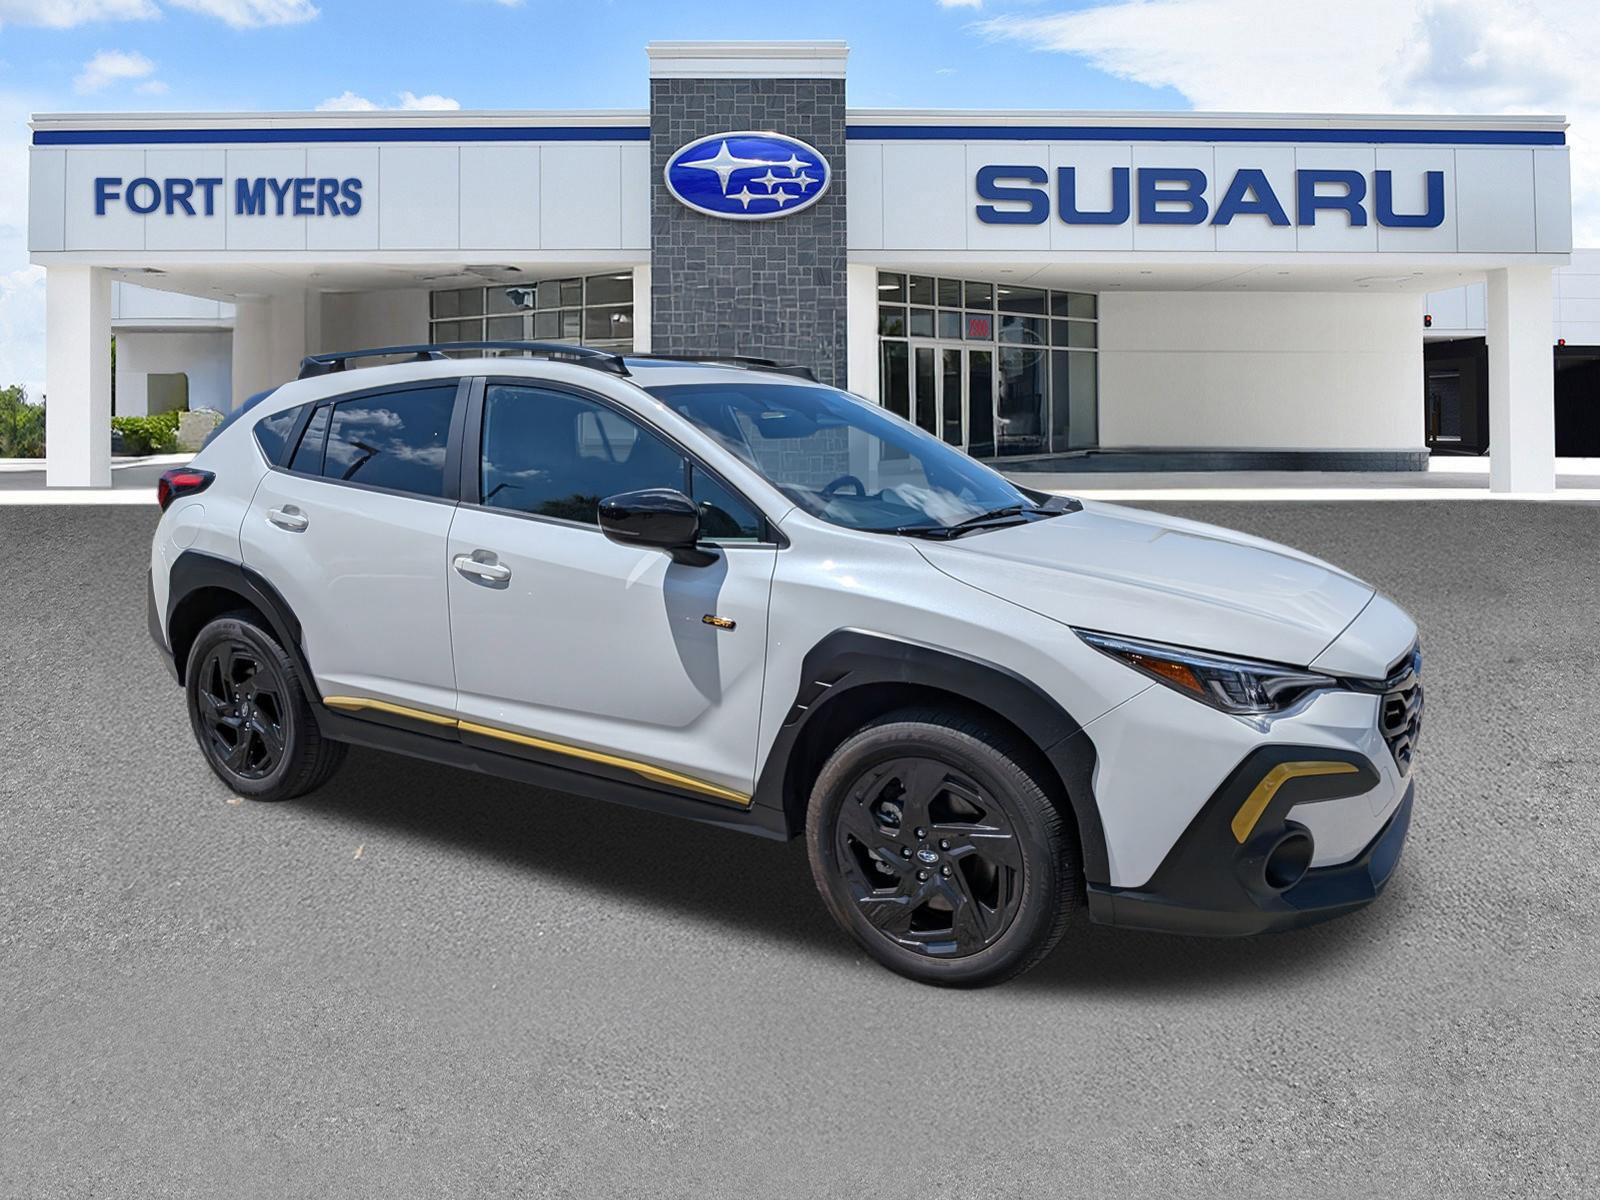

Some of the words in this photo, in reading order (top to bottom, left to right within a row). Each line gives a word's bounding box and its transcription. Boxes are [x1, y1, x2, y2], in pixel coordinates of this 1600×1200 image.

[94, 176, 223, 216] FORT
[235, 177, 363, 217] MYERS
[976, 164, 1445, 229] SUBARU
